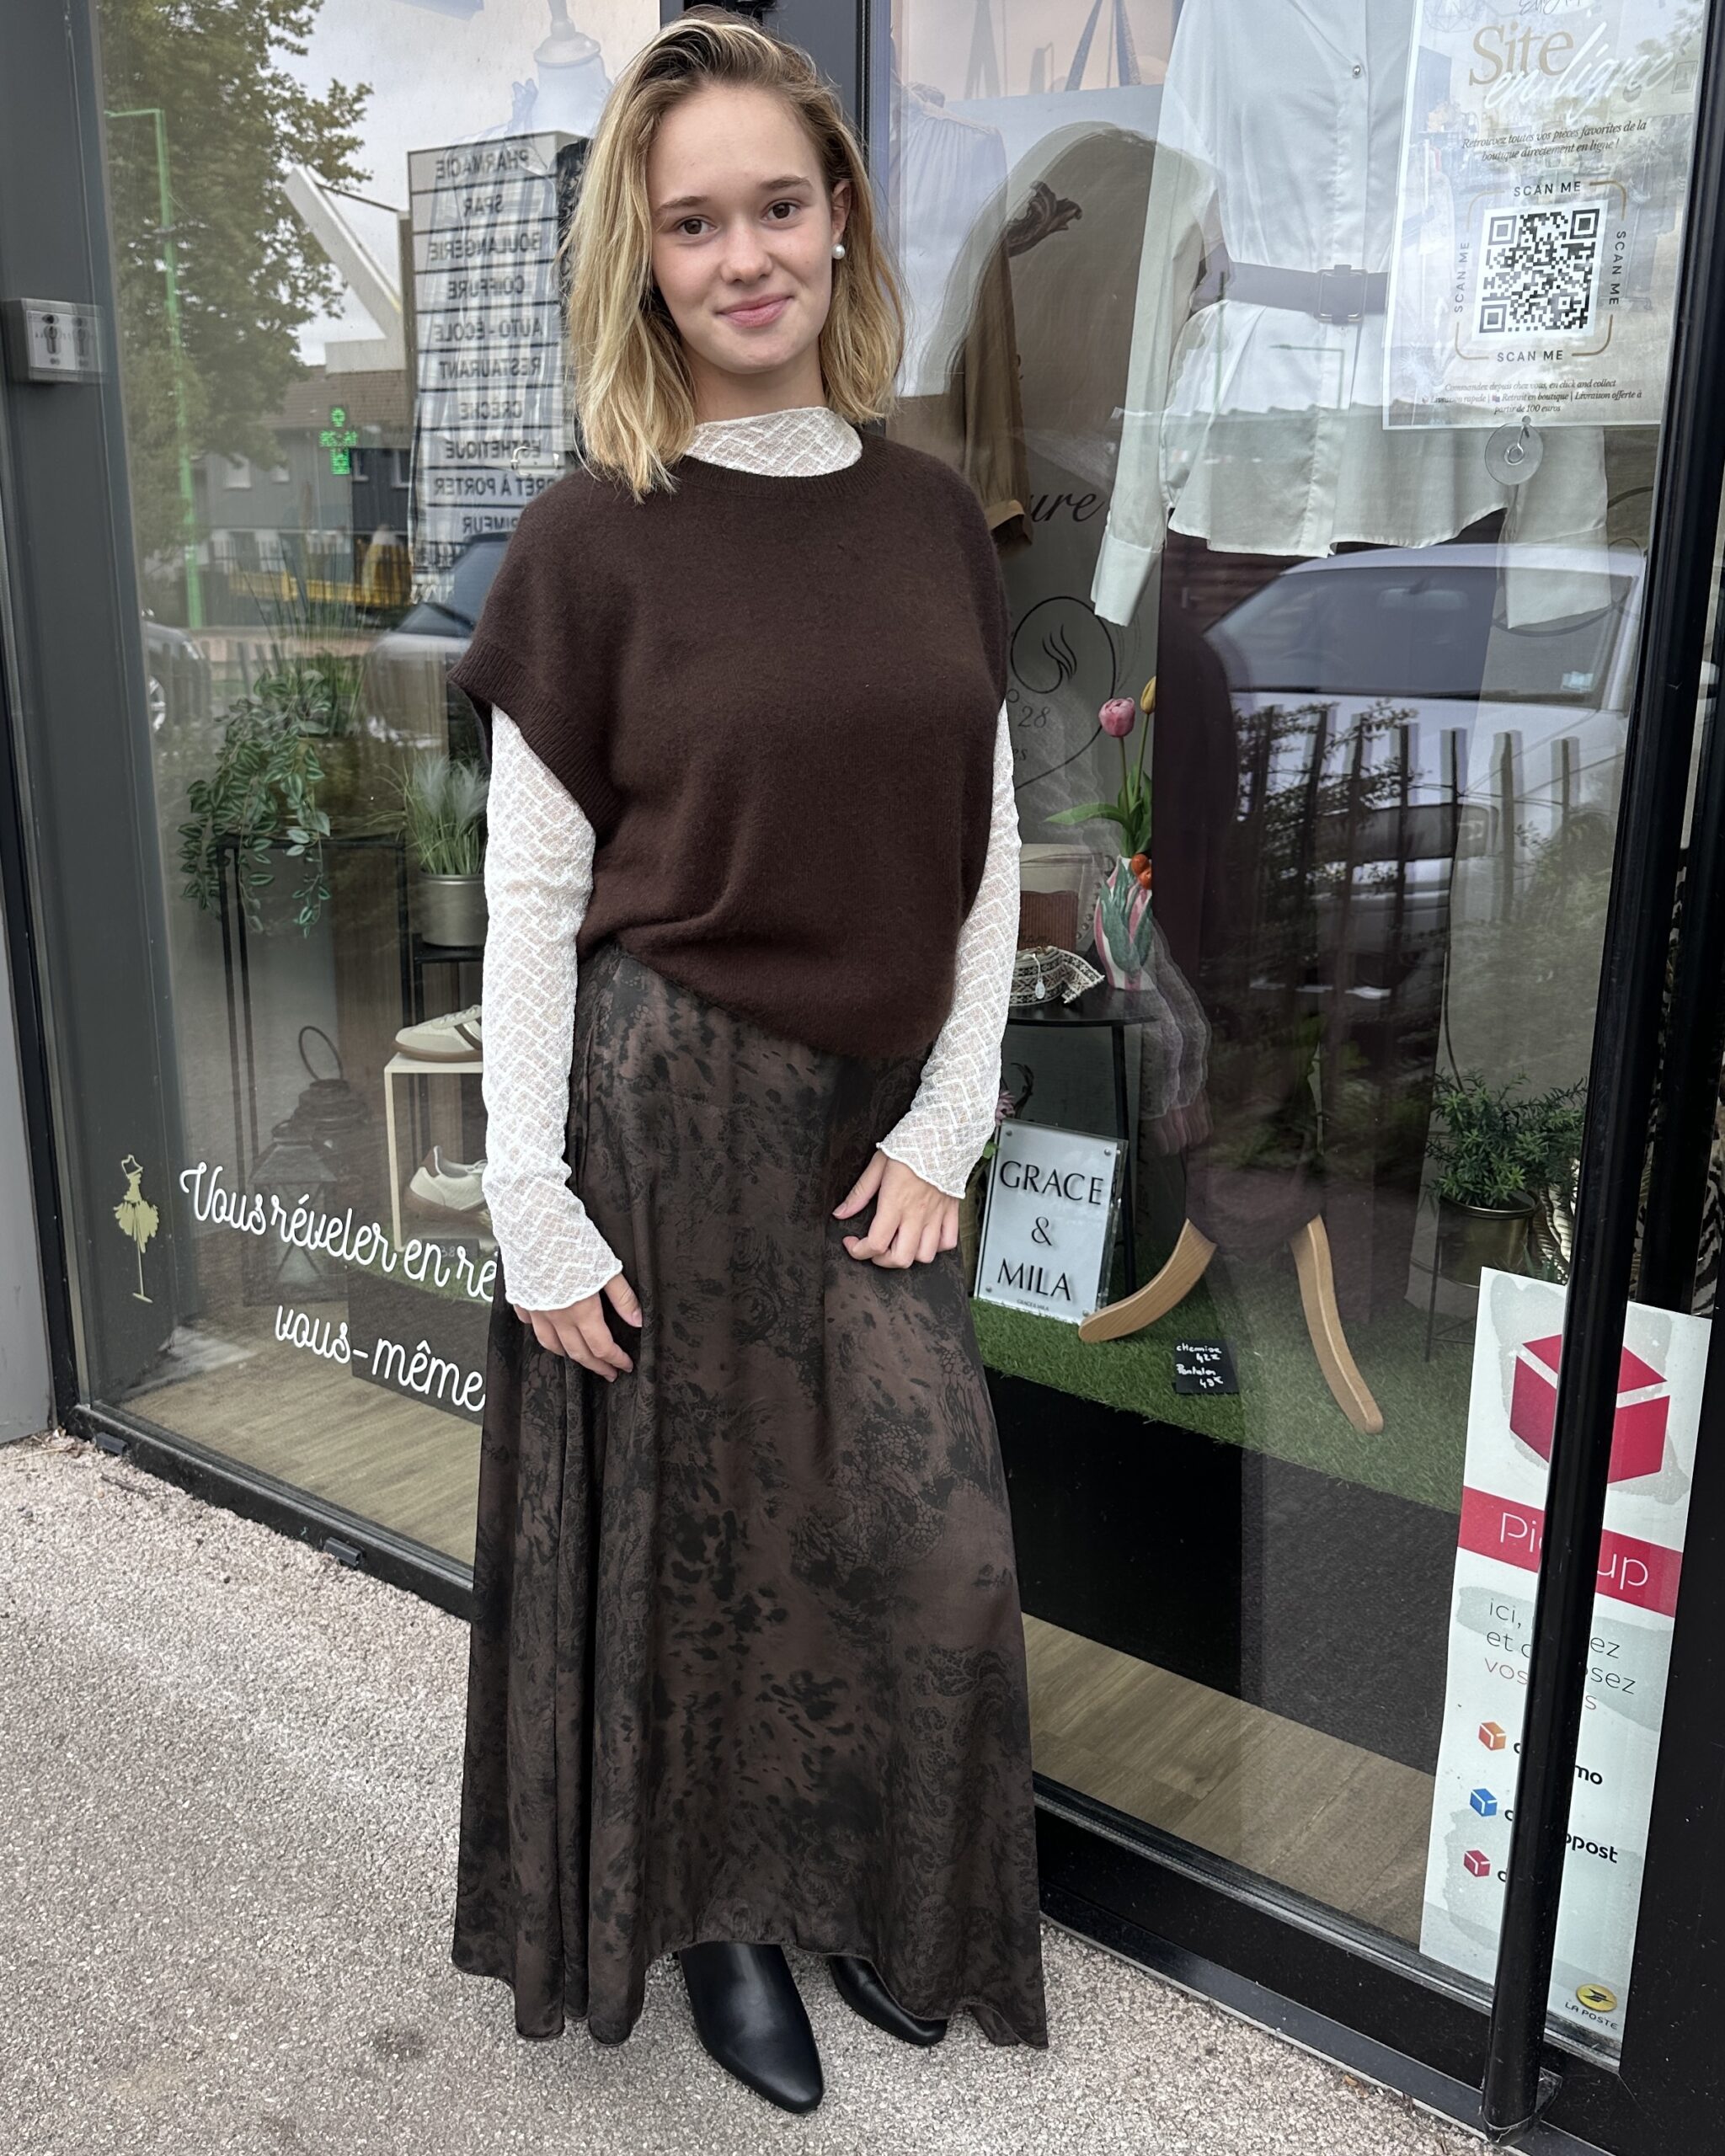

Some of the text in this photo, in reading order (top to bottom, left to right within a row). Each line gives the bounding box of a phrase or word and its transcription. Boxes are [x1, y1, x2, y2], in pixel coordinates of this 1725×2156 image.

[1469, 21, 1573, 86] Site
[1485, 22, 1674, 123] en ligne
[1462, 136, 1506, 148] Retrouvez
[1509, 134, 1534, 144] toutes
[1536, 132, 1551, 141] vos
[1578, 123, 1622, 140] favorites
[1623, 120, 1636, 132] de
[1637, 119, 1647, 131] la
[1482, 150, 1519, 162] boutique
[1521, 143, 1574, 157] directement
[1576, 143, 1588, 152] en
[1590, 139, 1613, 152] ligne
[1514, 181, 1581, 197] SCAN ME
[1454, 242, 1470, 312] SCAN ME
[1610, 231, 1626, 305] SCAN ME
[1497, 350, 1563, 362] SCAN ME
[1537, 392, 1568, 403] boutique
[1574, 391, 1610, 400] Livraison
[1611, 389, 1636, 401] offerte
[1559, 379, 1575, 388] click
[1577, 379, 1592, 388] and
[1593, 378, 1616, 387] collect
[1493, 405, 1516, 415] partir
[1525, 404, 1541, 413] 100
[1000, 1161, 1103, 1205] GRACE
[179, 1161, 266, 1235] Vous
[403, 1238, 451, 1288] en
[1031, 1216, 1052, 1246] &
[997, 1257, 1071, 1301] MILA
[275, 1305, 486, 1412] vous-même
[1489, 1598, 1521, 1629] ici,
[1487, 1631, 1513, 1652] et
[1485, 1657, 1529, 1685] vos
[1565, 2001, 1618, 2030] LA POSTE
